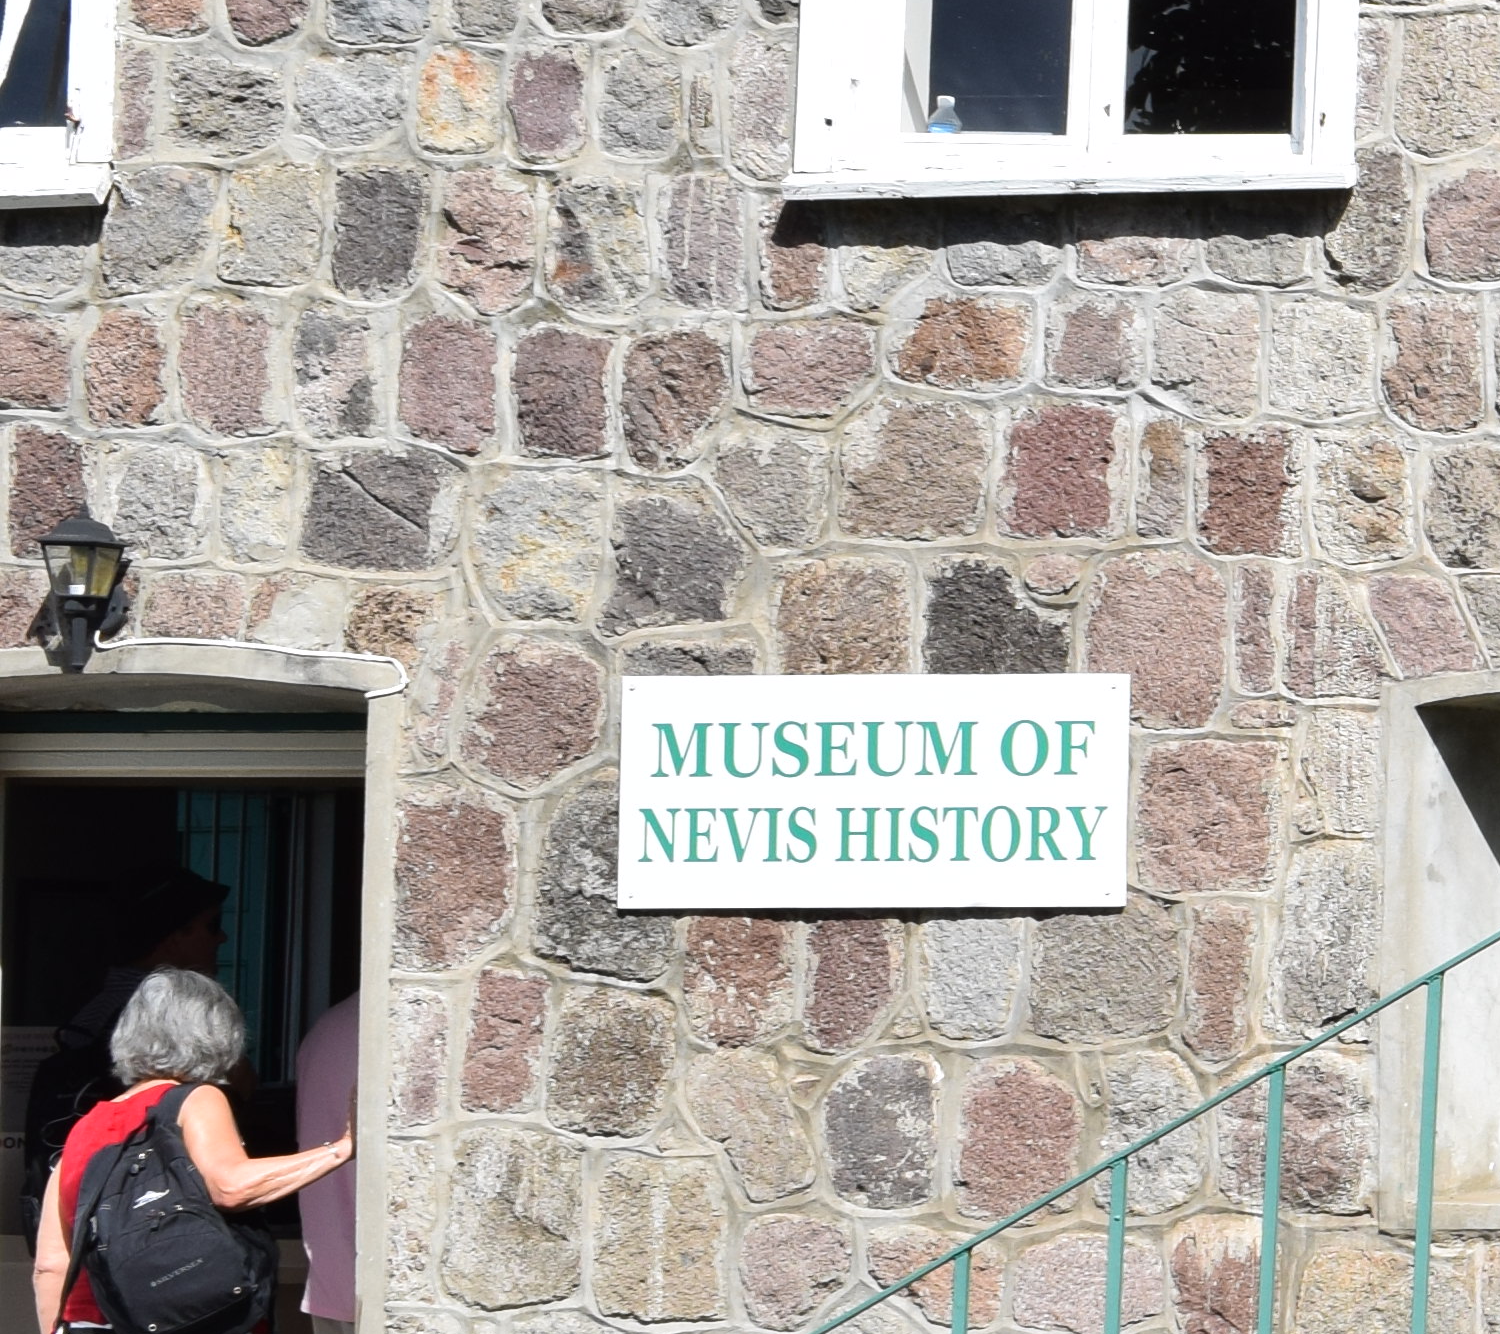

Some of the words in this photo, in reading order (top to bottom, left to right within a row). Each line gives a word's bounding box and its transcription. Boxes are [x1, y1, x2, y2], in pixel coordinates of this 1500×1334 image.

[650, 720, 979, 779] MUSEUM
[999, 719, 1096, 777] OF
[637, 806, 818, 864] NEVIS
[834, 805, 1109, 864] HISTORY
